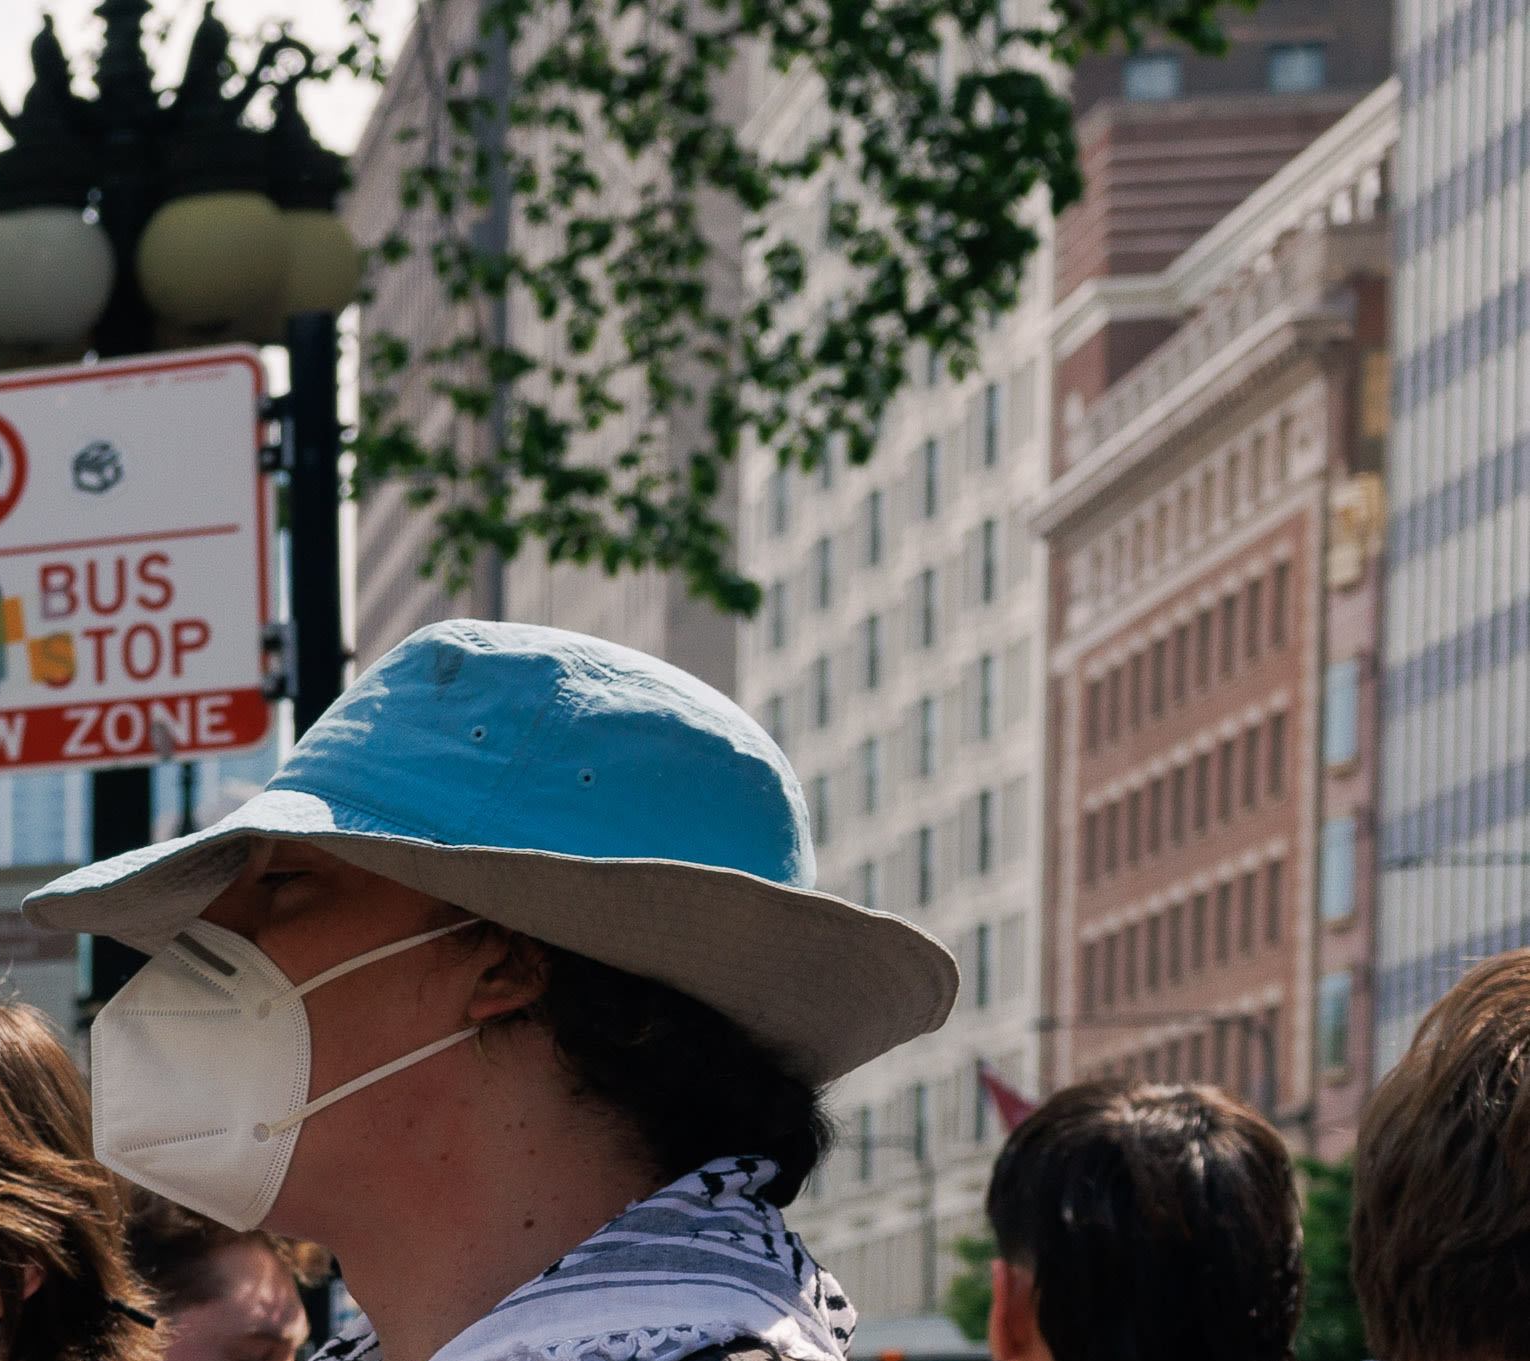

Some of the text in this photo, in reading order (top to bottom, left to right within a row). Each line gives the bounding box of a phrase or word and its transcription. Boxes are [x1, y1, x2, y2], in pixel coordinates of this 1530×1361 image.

[39, 552, 175, 621] BUS
[42, 620, 212, 690] STOP
[61, 695, 238, 759] ZONE
